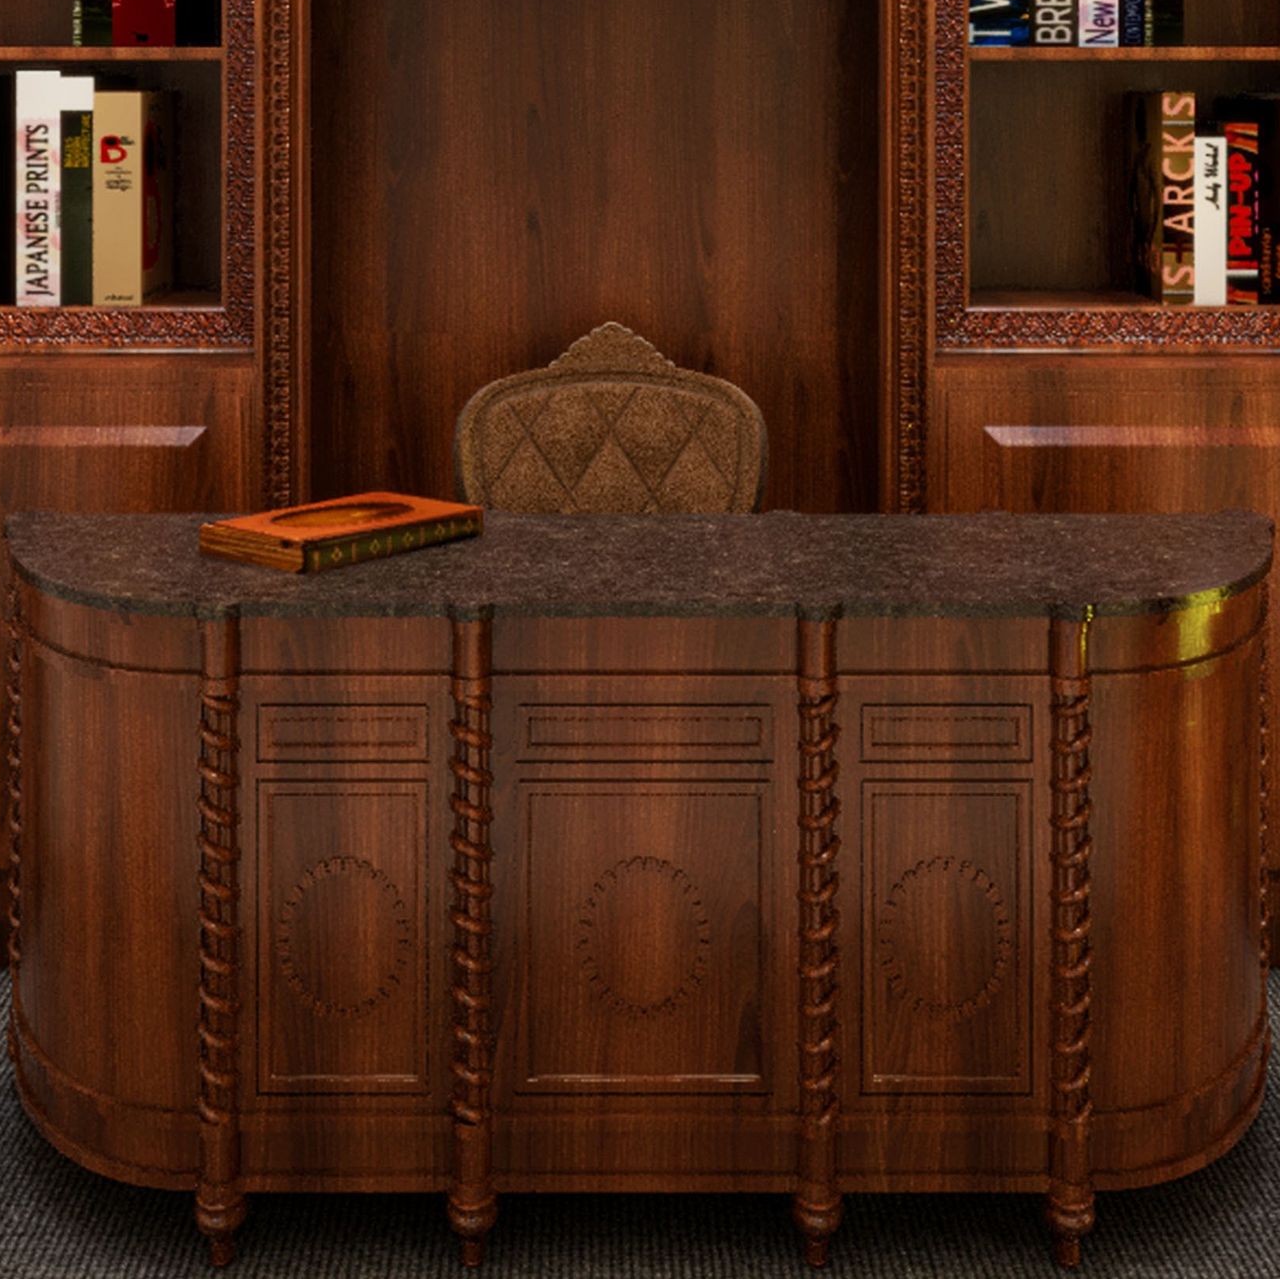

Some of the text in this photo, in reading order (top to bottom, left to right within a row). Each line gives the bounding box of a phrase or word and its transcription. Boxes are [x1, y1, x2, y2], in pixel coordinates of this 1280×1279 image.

[1086, 2, 1114, 44] New
[25, 124, 53, 296] JAPANESE PRINTS
[1228, 152, 1253, 256] PIN-UP
